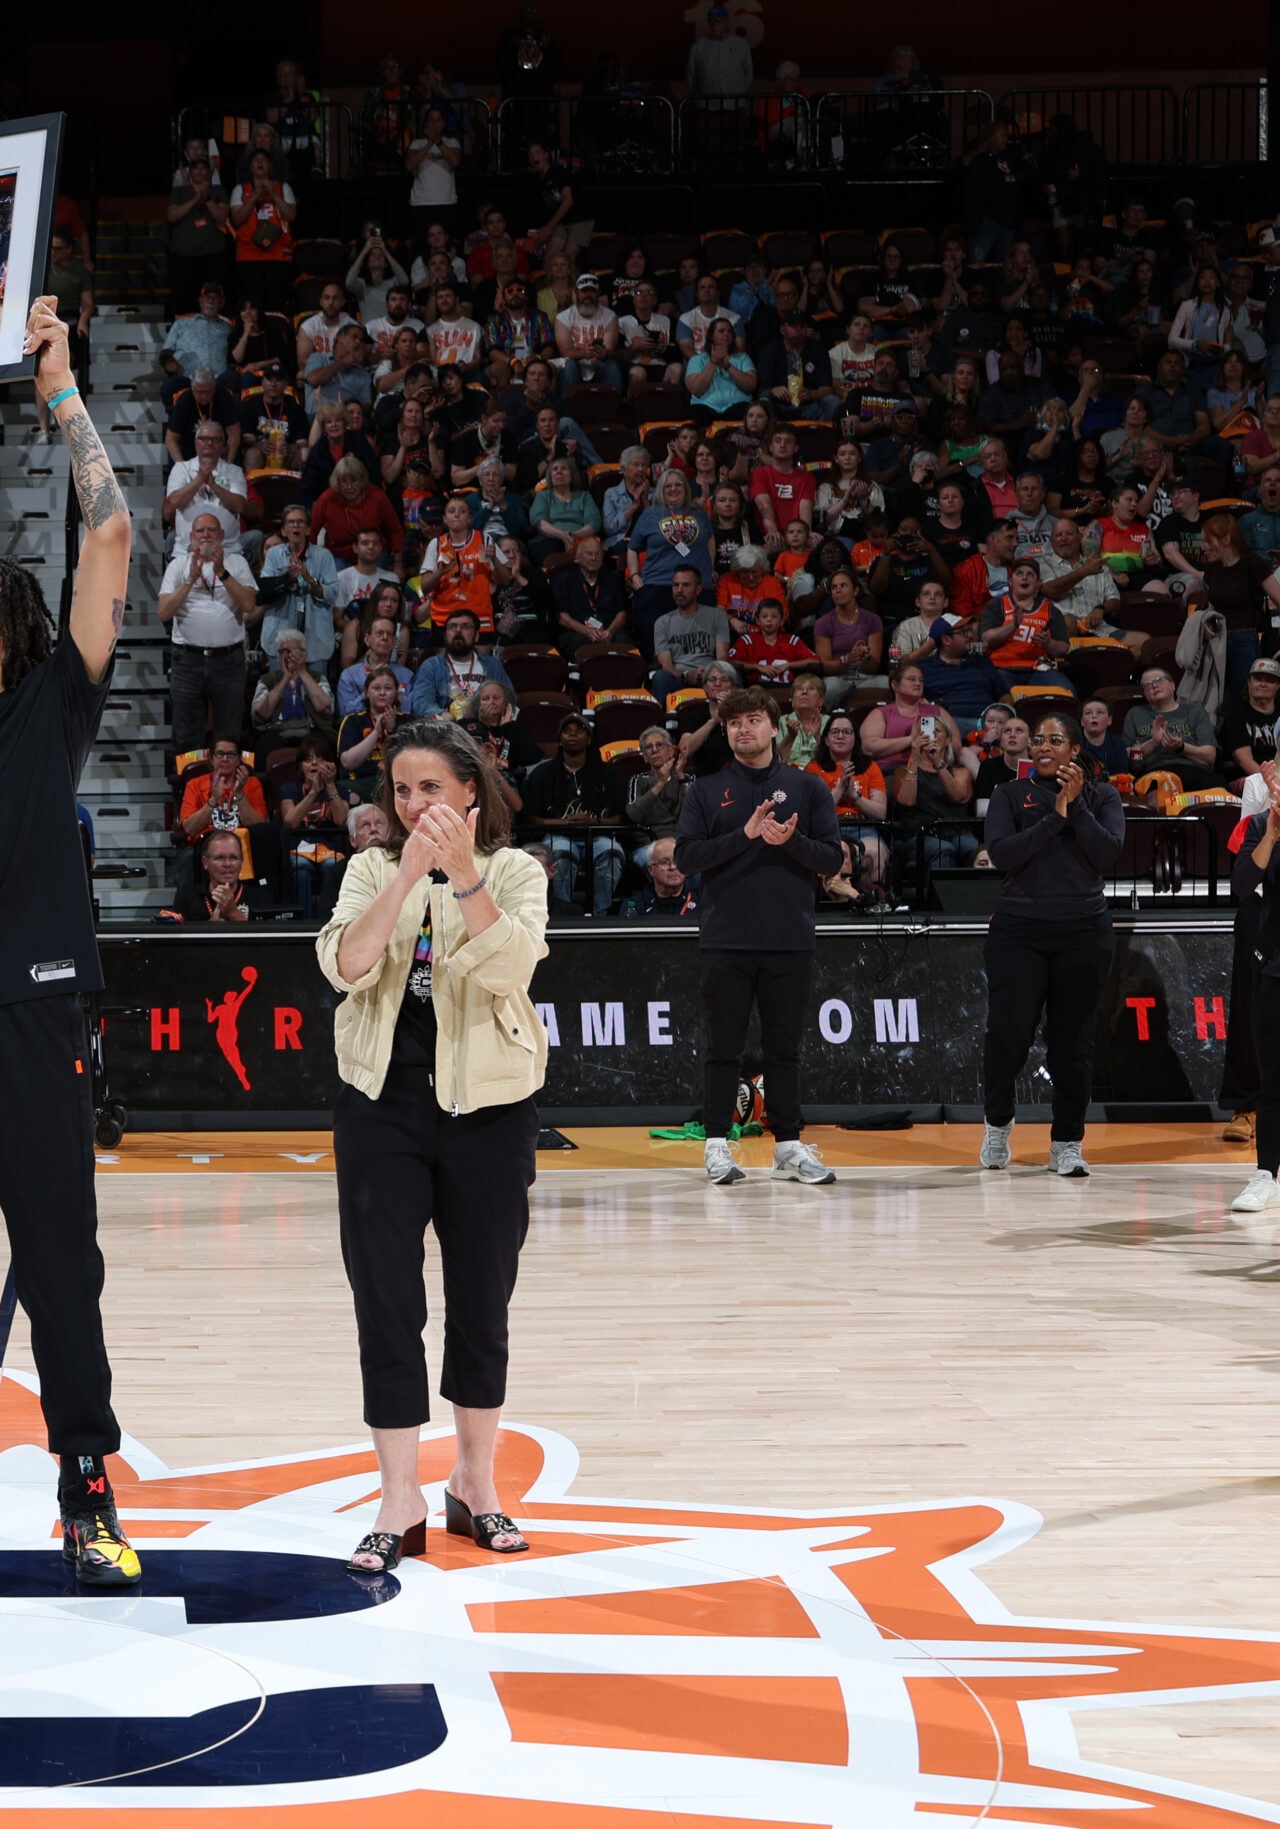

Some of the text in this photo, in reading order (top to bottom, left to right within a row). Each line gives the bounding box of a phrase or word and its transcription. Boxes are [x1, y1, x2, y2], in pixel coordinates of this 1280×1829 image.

[434, 331, 475, 351] SUN
[1012, 624, 1037, 643] 31
[1169, 794, 1201, 807] PROUD
